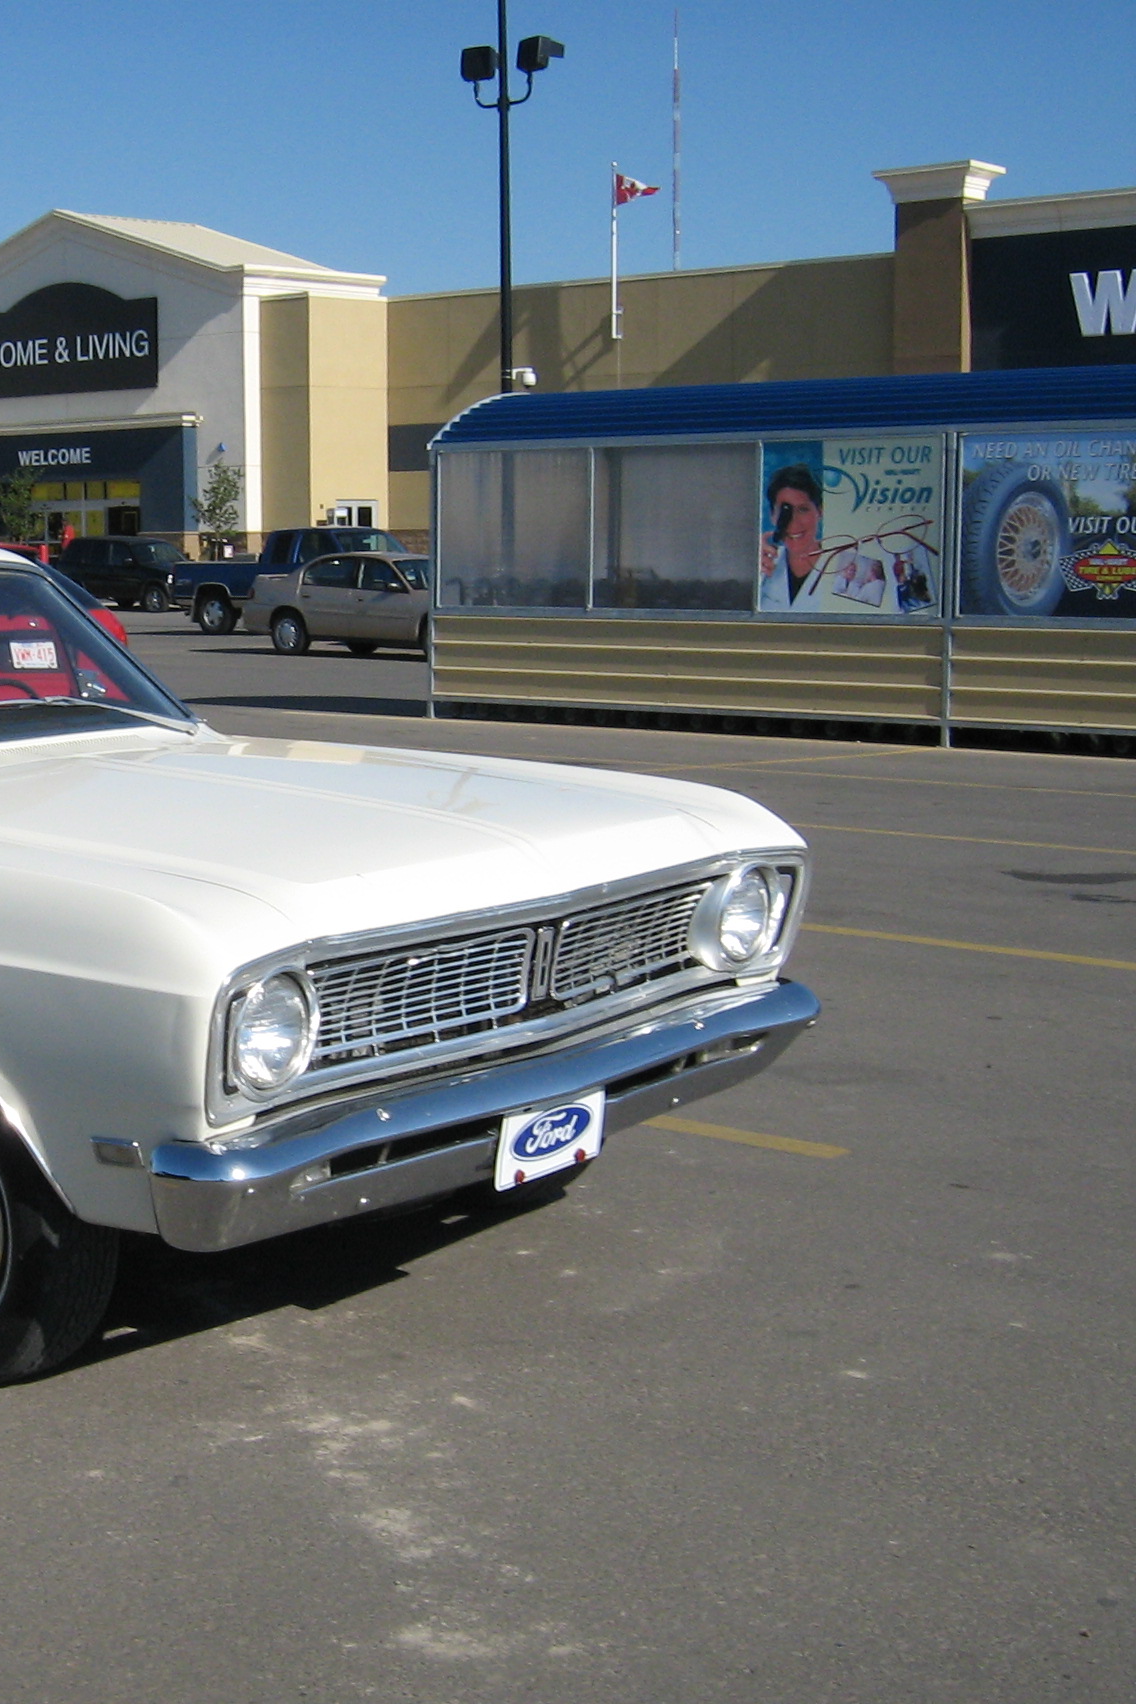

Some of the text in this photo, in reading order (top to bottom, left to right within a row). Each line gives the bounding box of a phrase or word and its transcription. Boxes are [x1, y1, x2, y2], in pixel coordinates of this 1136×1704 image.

[55, 336, 70, 363] &
[76, 329, 150, 362] LIVING
[18, 448, 91, 466] WELCOME
[839, 446, 932, 465] VISIT OUR
[972, 441, 1016, 459] NEED
[1023, 443, 1048, 457] AN
[1054, 440, 1081, 458] OIL
[1027, 464, 1051, 481] OR
[1058, 464, 1100, 481] NEW
[852, 472, 933, 513] Vision
[1068, 516, 1112, 534] VISIT
[525, 1112, 579, 1154] Ford
